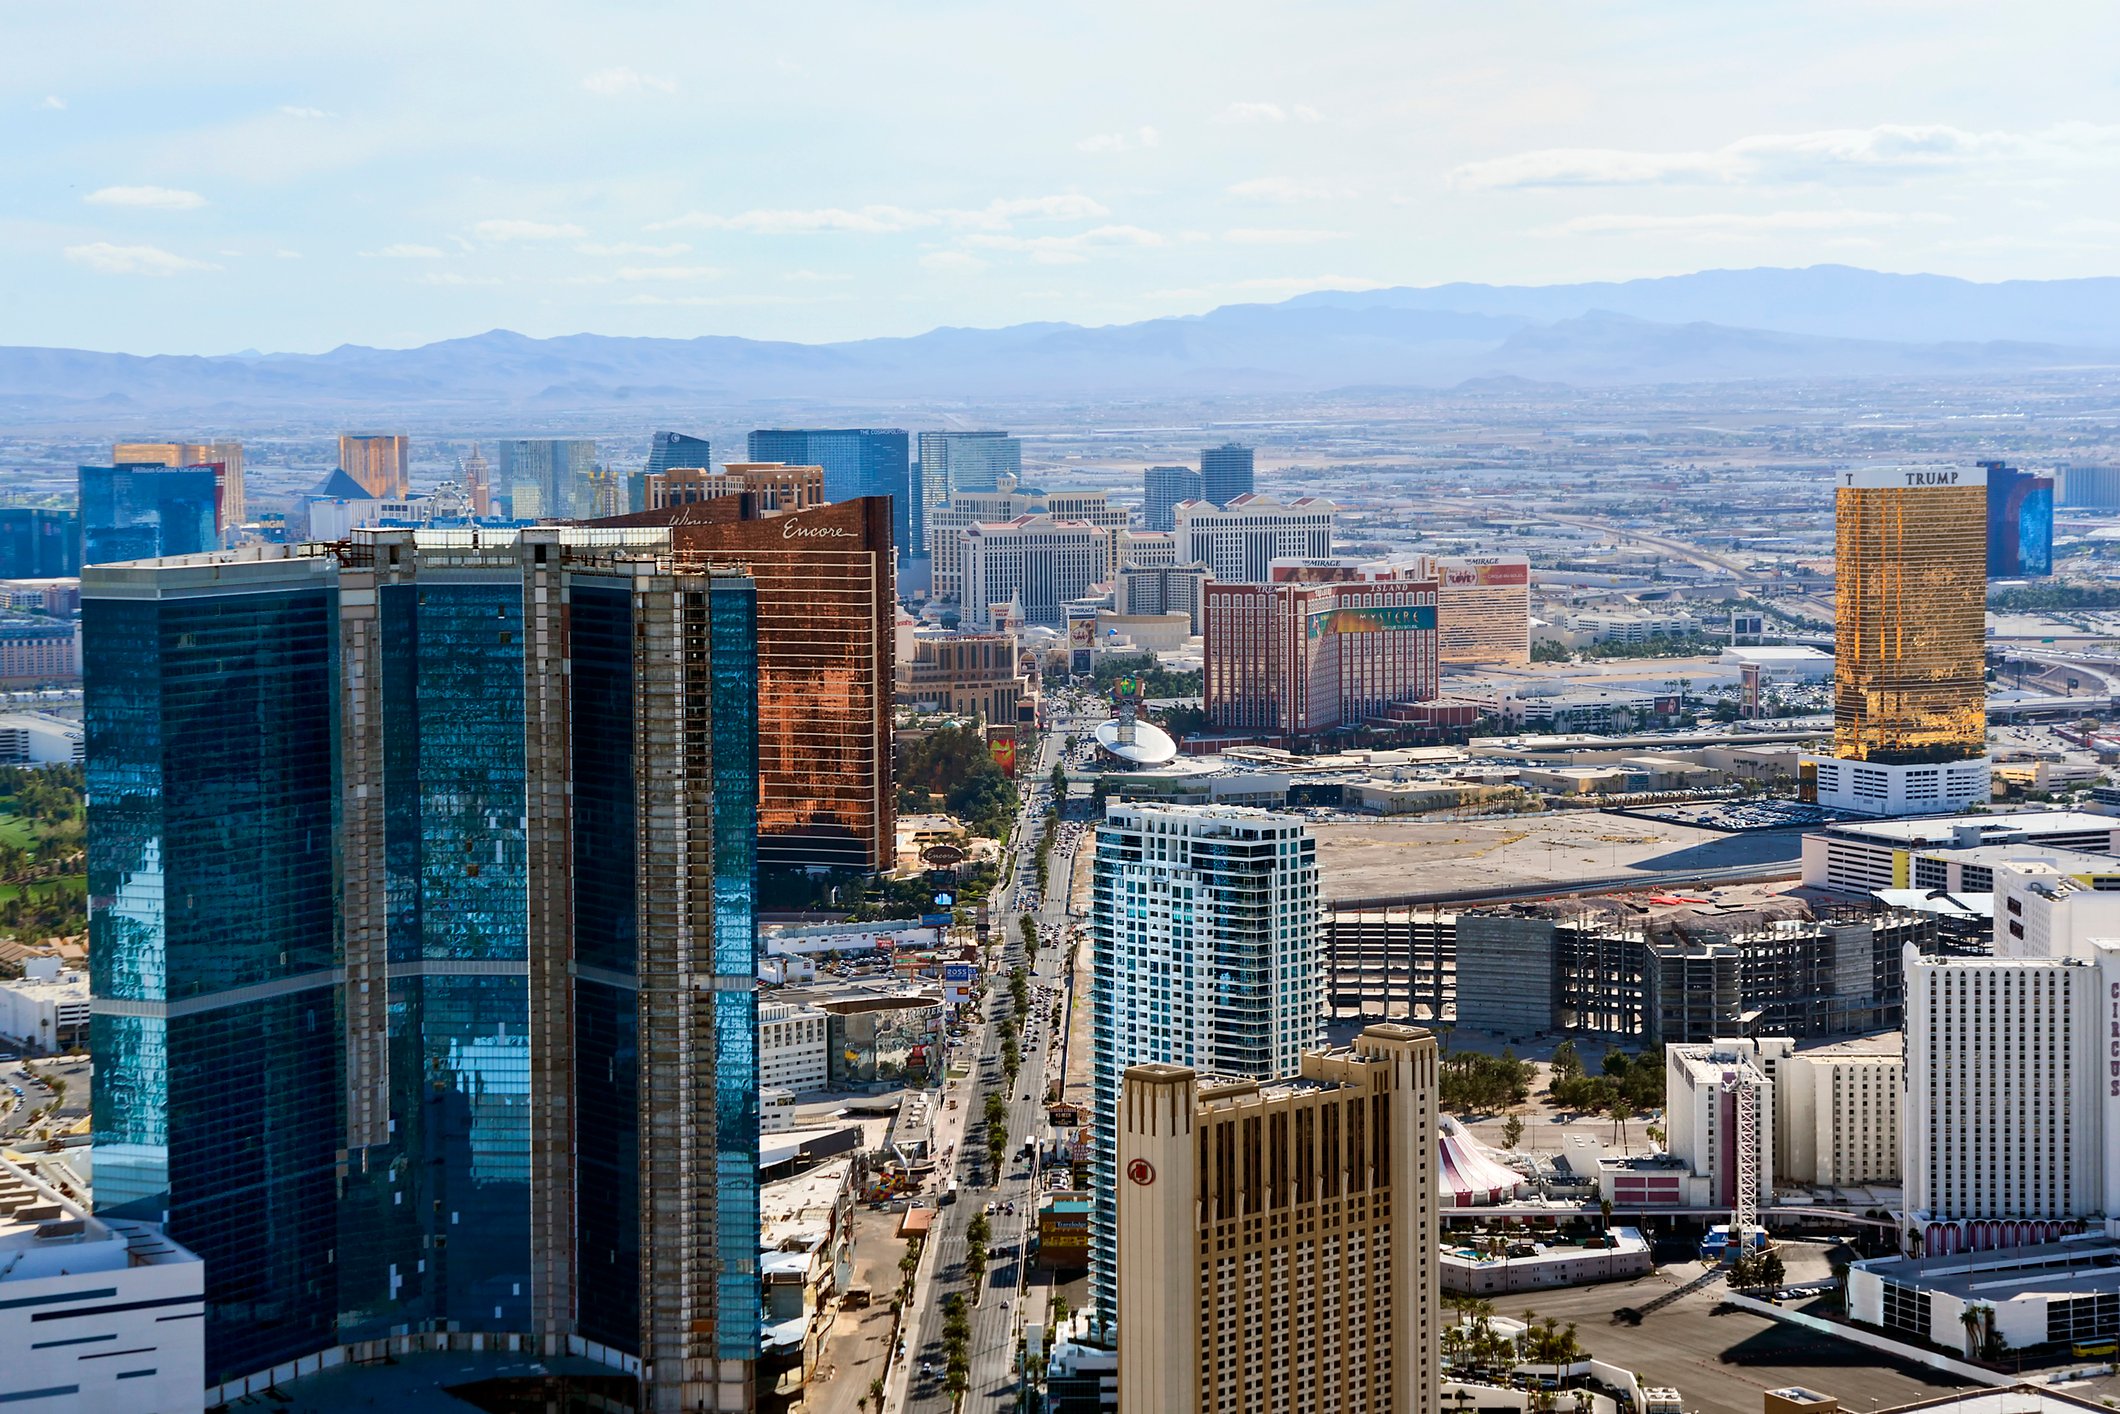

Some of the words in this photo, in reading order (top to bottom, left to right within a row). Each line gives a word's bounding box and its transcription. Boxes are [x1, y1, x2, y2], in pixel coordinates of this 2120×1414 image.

[1845, 473, 1853, 485] T
[1905, 472, 1959, 485] TRUMP
[260, 520, 285, 529] MGM
[782, 517, 859, 539] Encore
[1370, 584, 1409, 592] ISLAND
[927, 850, 961, 859] Encore
[2110, 982, 2120, 1097] CIRCUS
